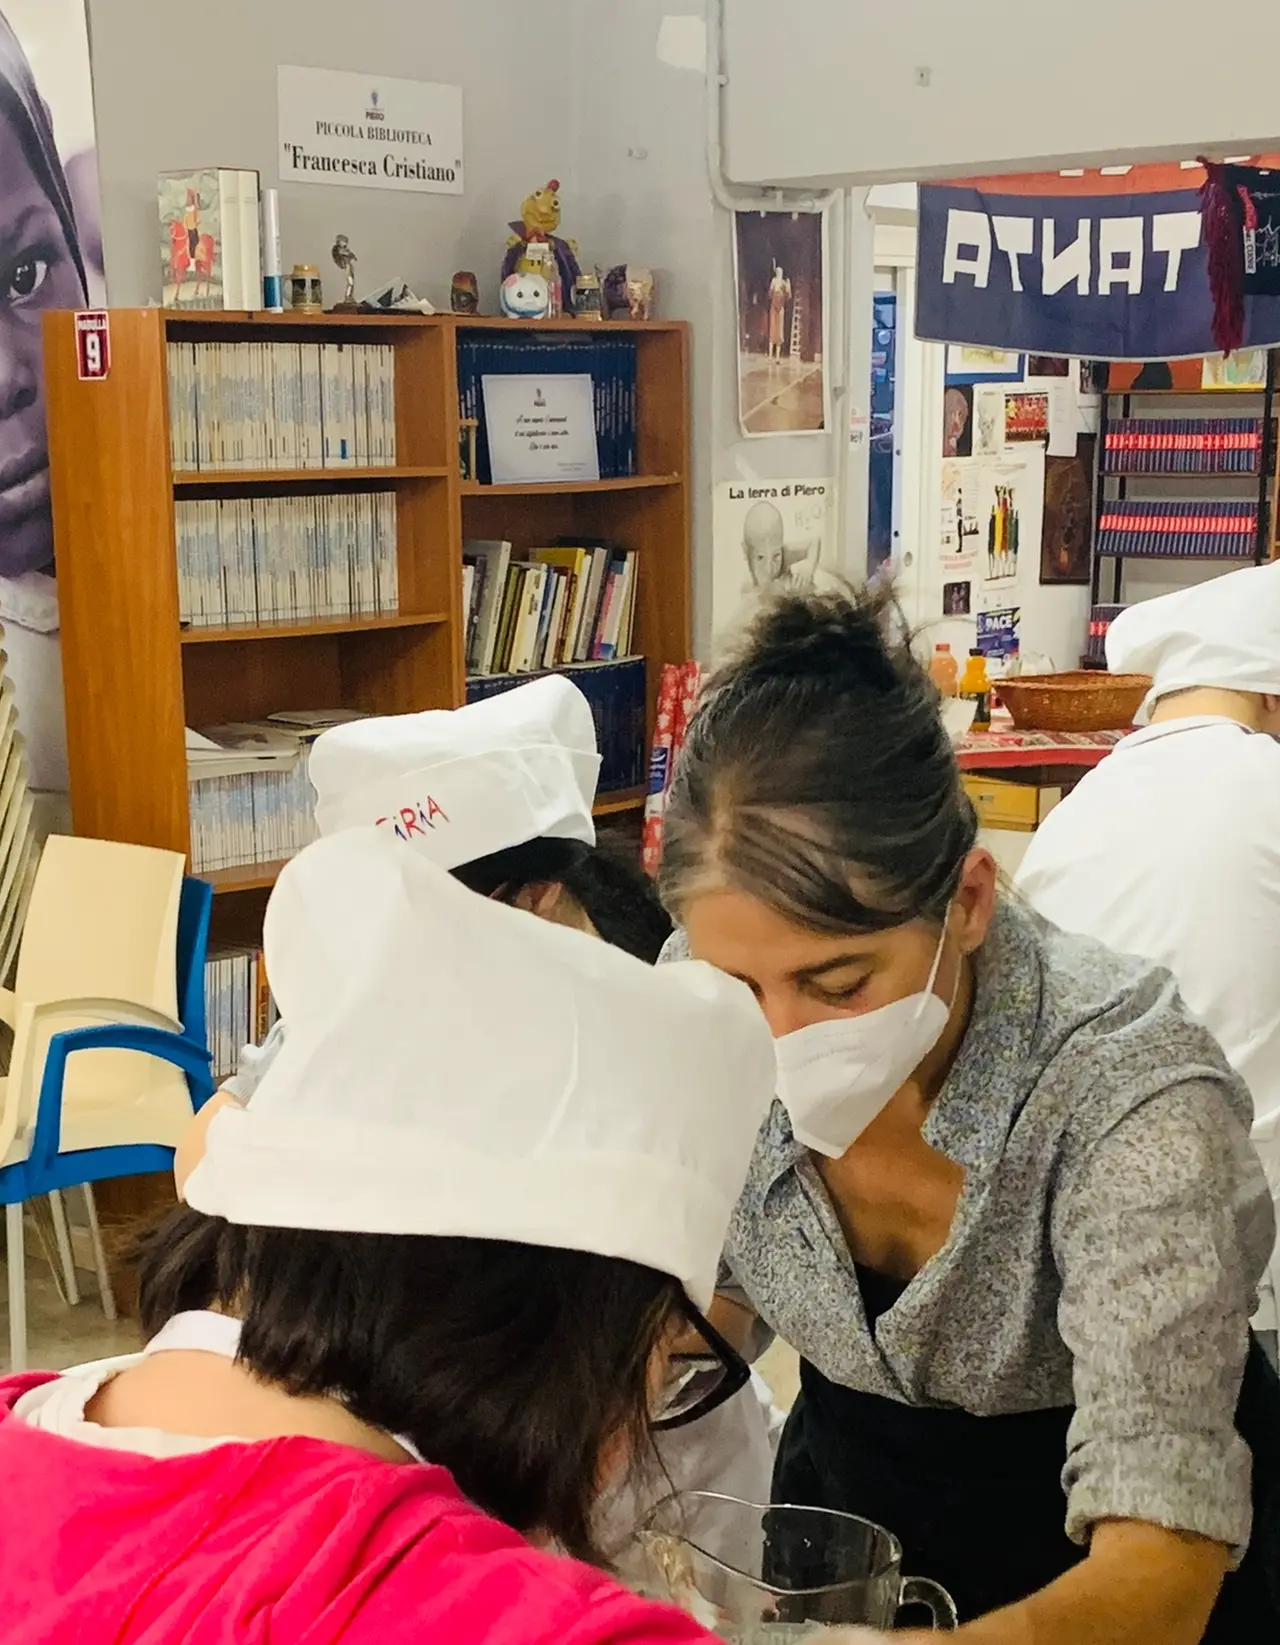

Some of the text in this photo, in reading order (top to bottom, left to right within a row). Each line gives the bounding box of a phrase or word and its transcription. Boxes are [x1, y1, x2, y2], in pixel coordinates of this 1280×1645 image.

[316, 120, 433, 146] PICCOLA BIBLIOTECA
[283, 142, 462, 184] "Francesca Cristiano"
[85, 332, 102, 373] 9
[729, 484, 826, 500] La terra di Piero
[985, 614, 1013, 632] PACE
